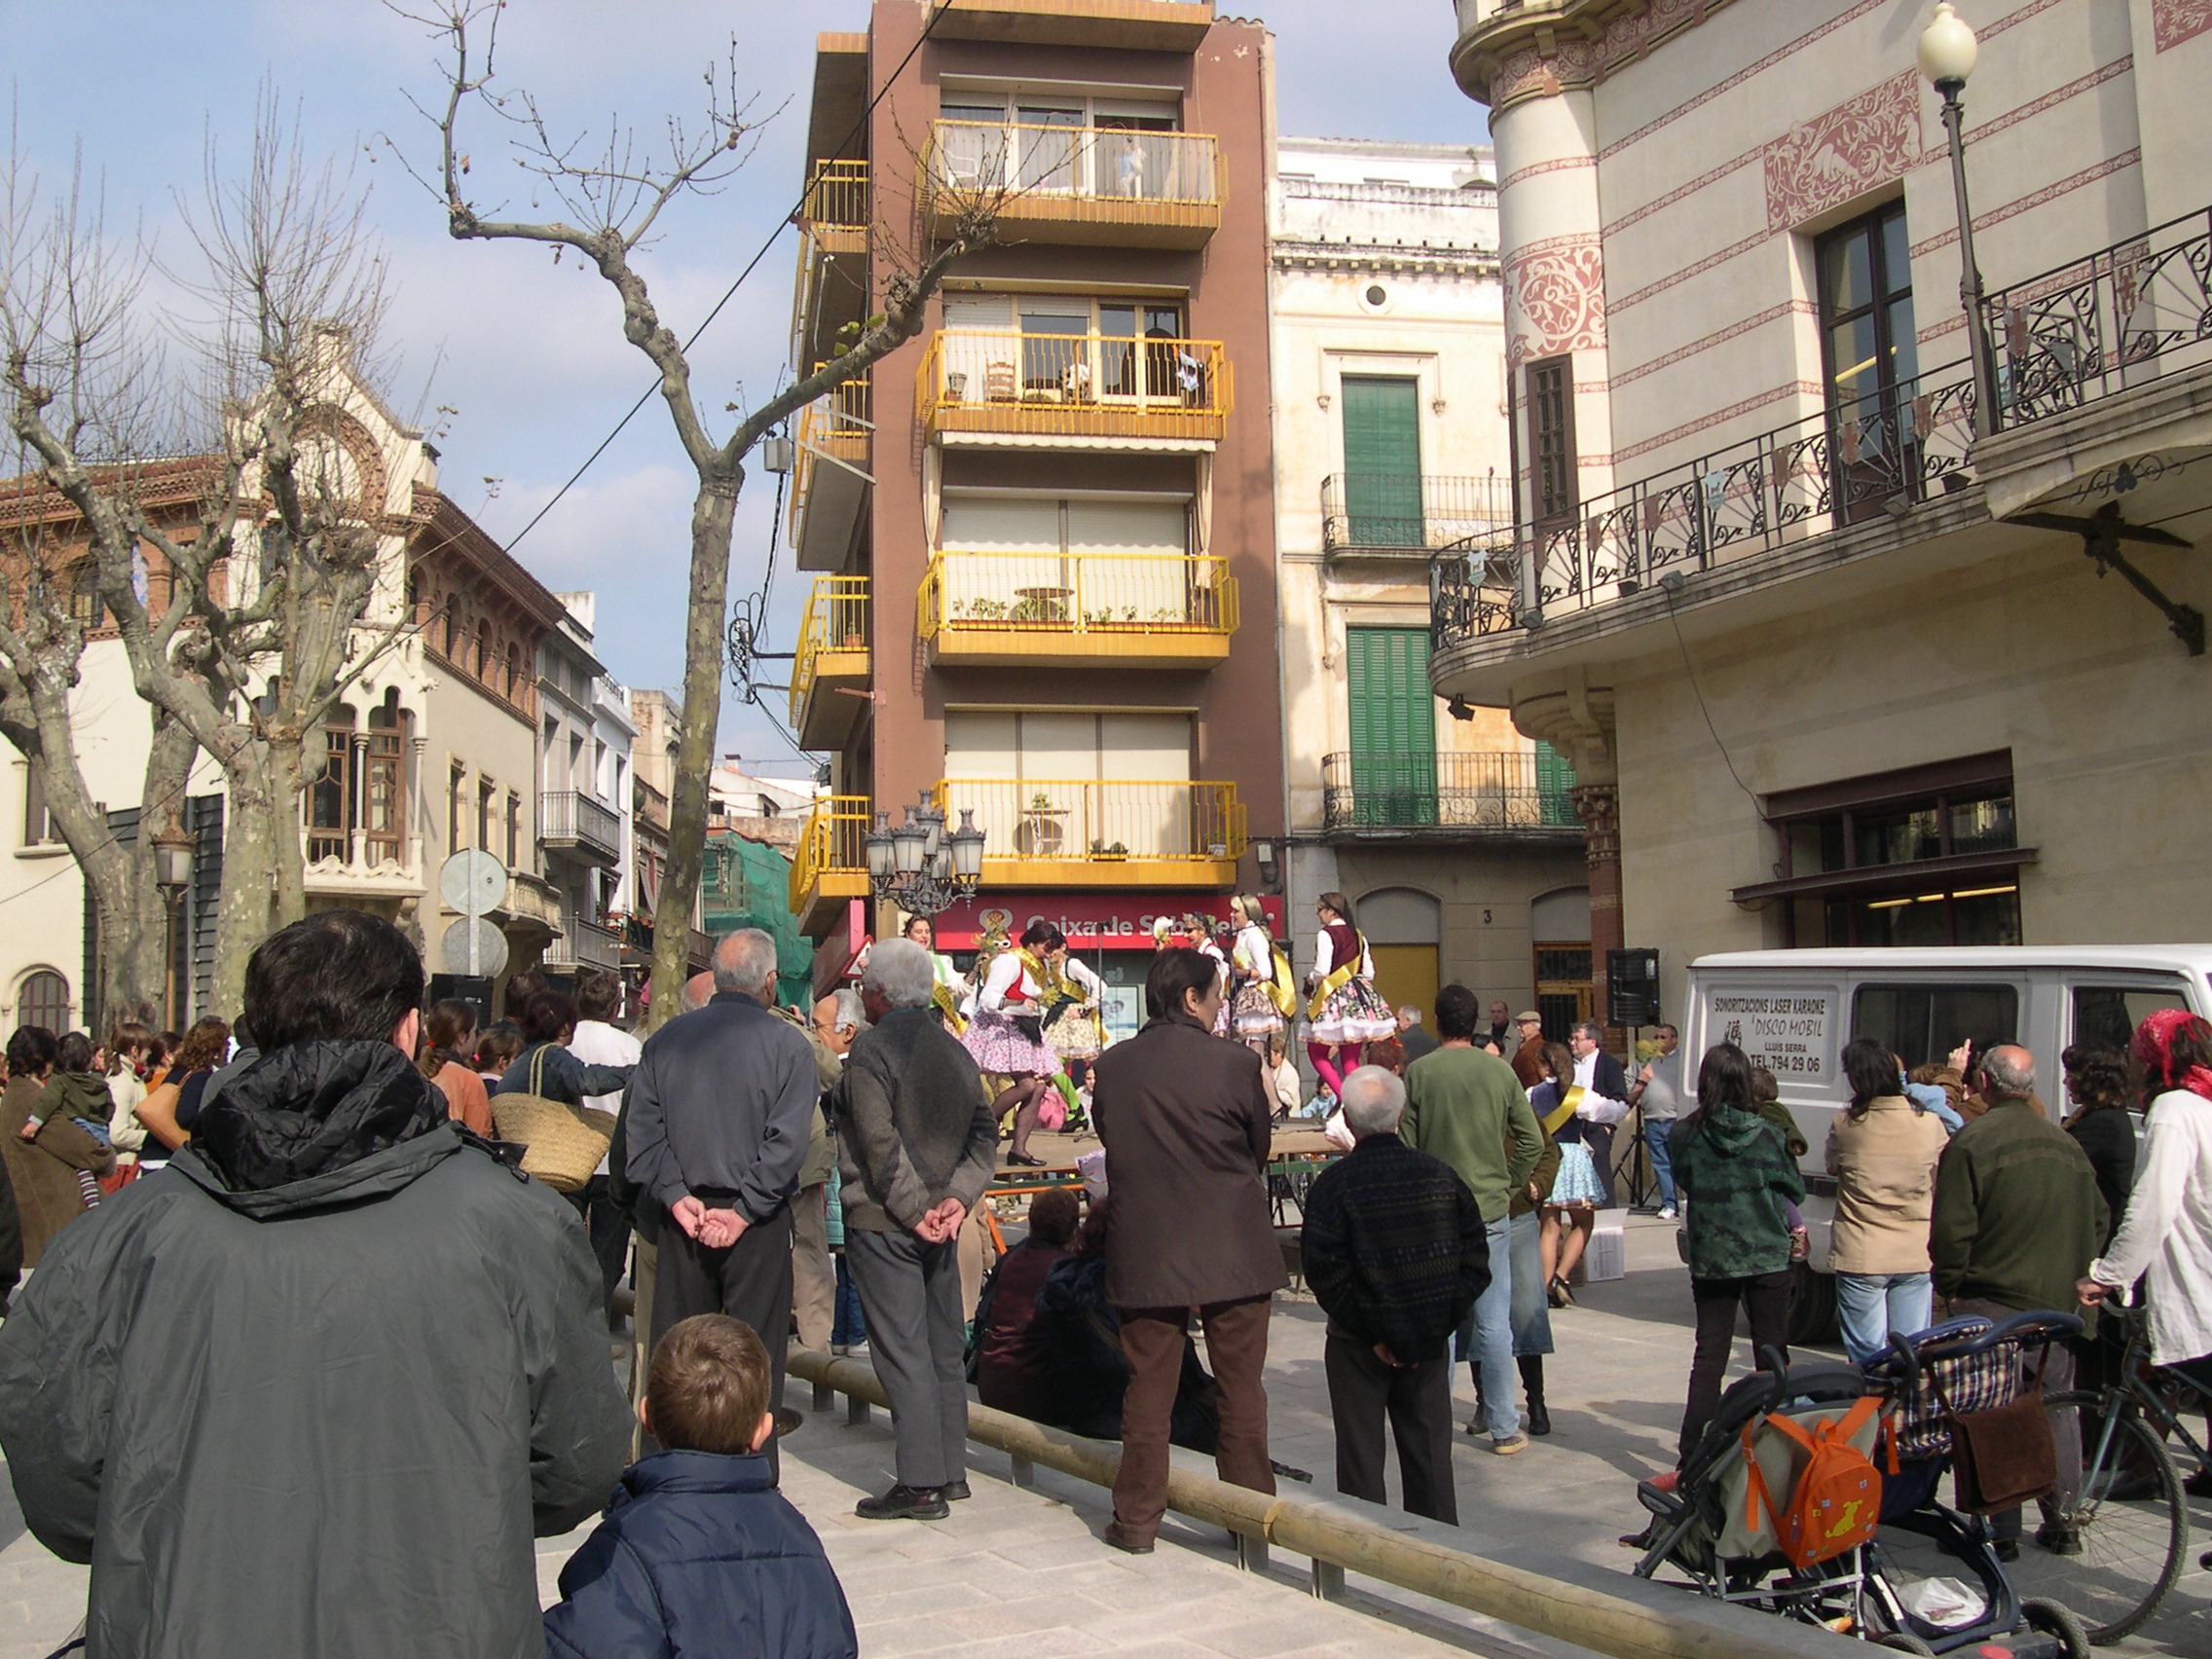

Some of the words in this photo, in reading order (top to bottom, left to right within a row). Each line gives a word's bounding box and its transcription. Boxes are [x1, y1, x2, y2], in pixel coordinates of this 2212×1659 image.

[1483, 909, 1492, 924] 3
[1103, 915, 1133, 937] de
[1770, 998, 1791, 1014] LASER
[1792, 999, 1825, 1014] KARAOKE
[1755, 1018, 1786, 1036] DISCO
[1788, 1019, 1823, 1037] MOBIL
[1785, 1043, 1807, 1052] SERRA
[1791, 1056, 1804, 1071] 29
[1807, 1057, 1820, 1072] 06
